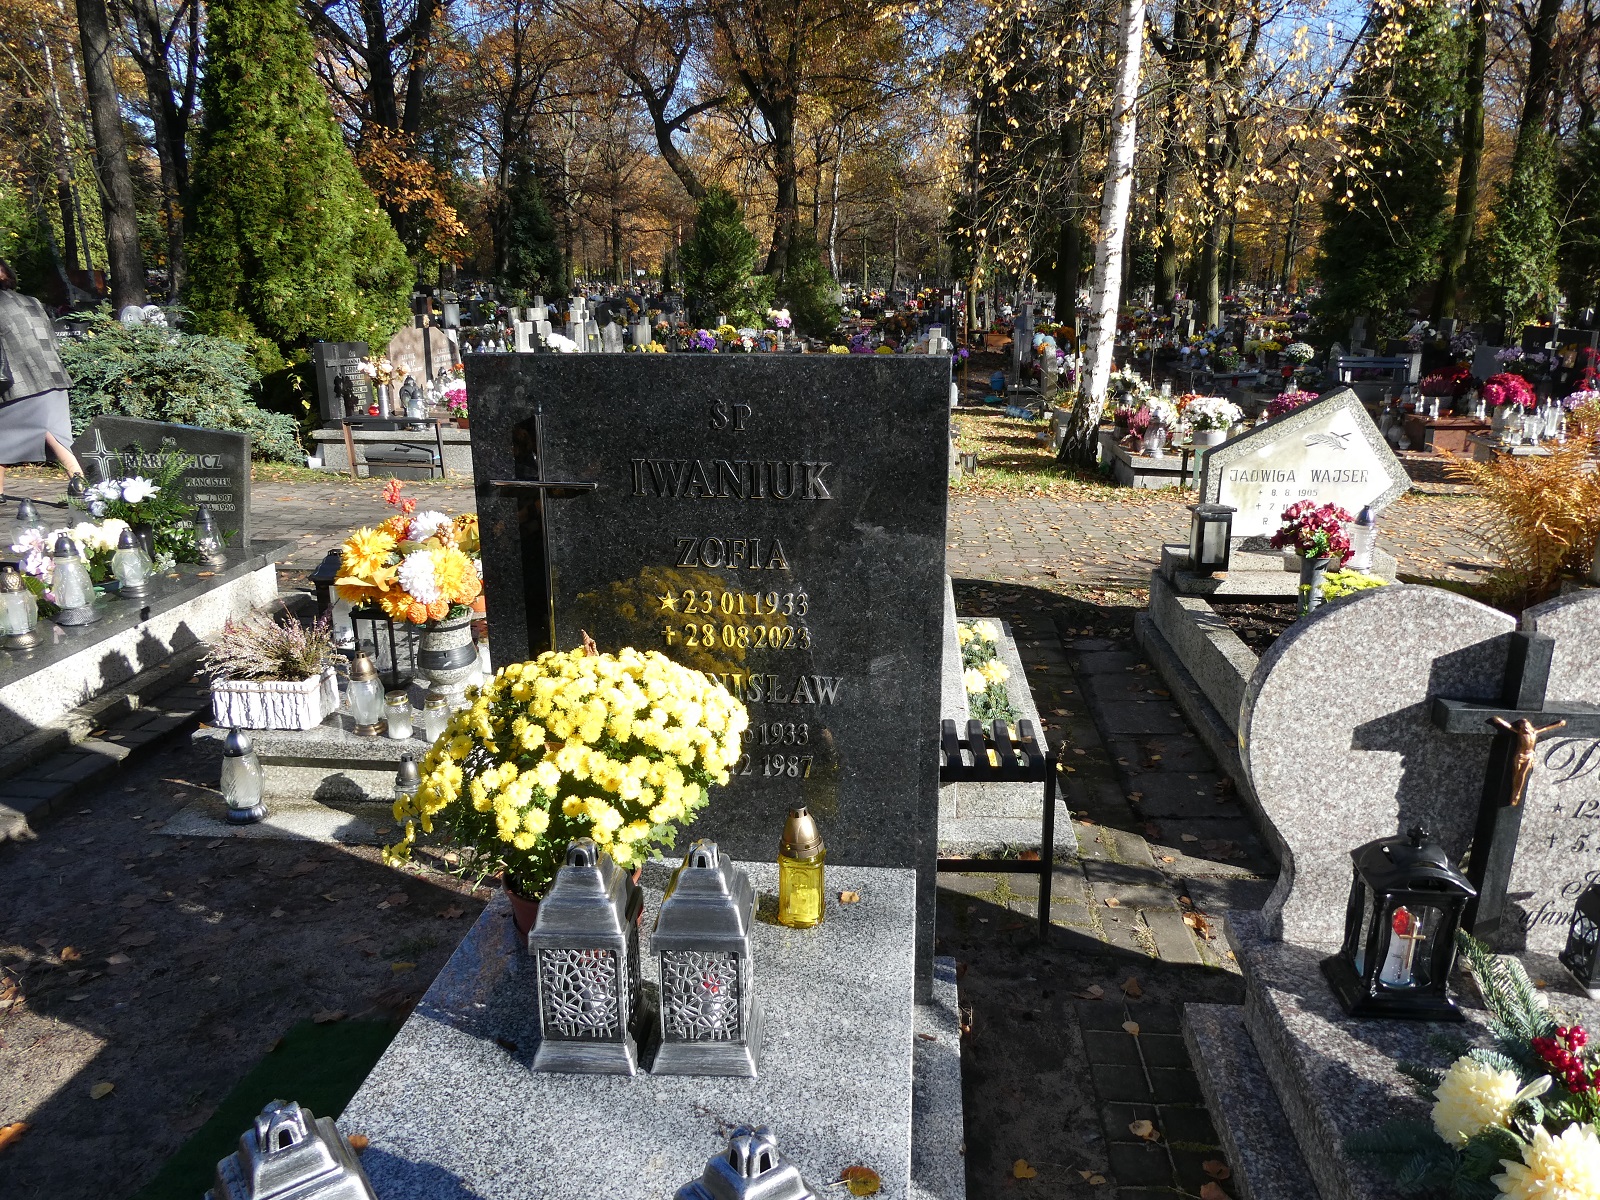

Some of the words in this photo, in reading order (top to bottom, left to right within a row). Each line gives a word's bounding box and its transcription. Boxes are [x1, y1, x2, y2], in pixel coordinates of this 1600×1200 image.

[184, 477, 232, 487] FRANCISZEK
[631, 458, 834, 500] IWANIUK
[1229, 470, 1296, 483] JADWIGA
[1310, 469, 1369, 483] WAJSER
[216, 494, 233, 503] 1907
[218, 503, 236, 512] 1990
[676, 537, 790, 570] ZOFIA
[683, 589, 713, 615] 23
[720, 590, 746, 616] 01
[753, 590, 809, 616] 1933
[684, 623, 715, 648] 28
[722, 624, 749, 649] 08
[753, 625, 812, 650] 2023
[759, 722, 810, 746] 1933
[761, 754, 814, 778] 1987
